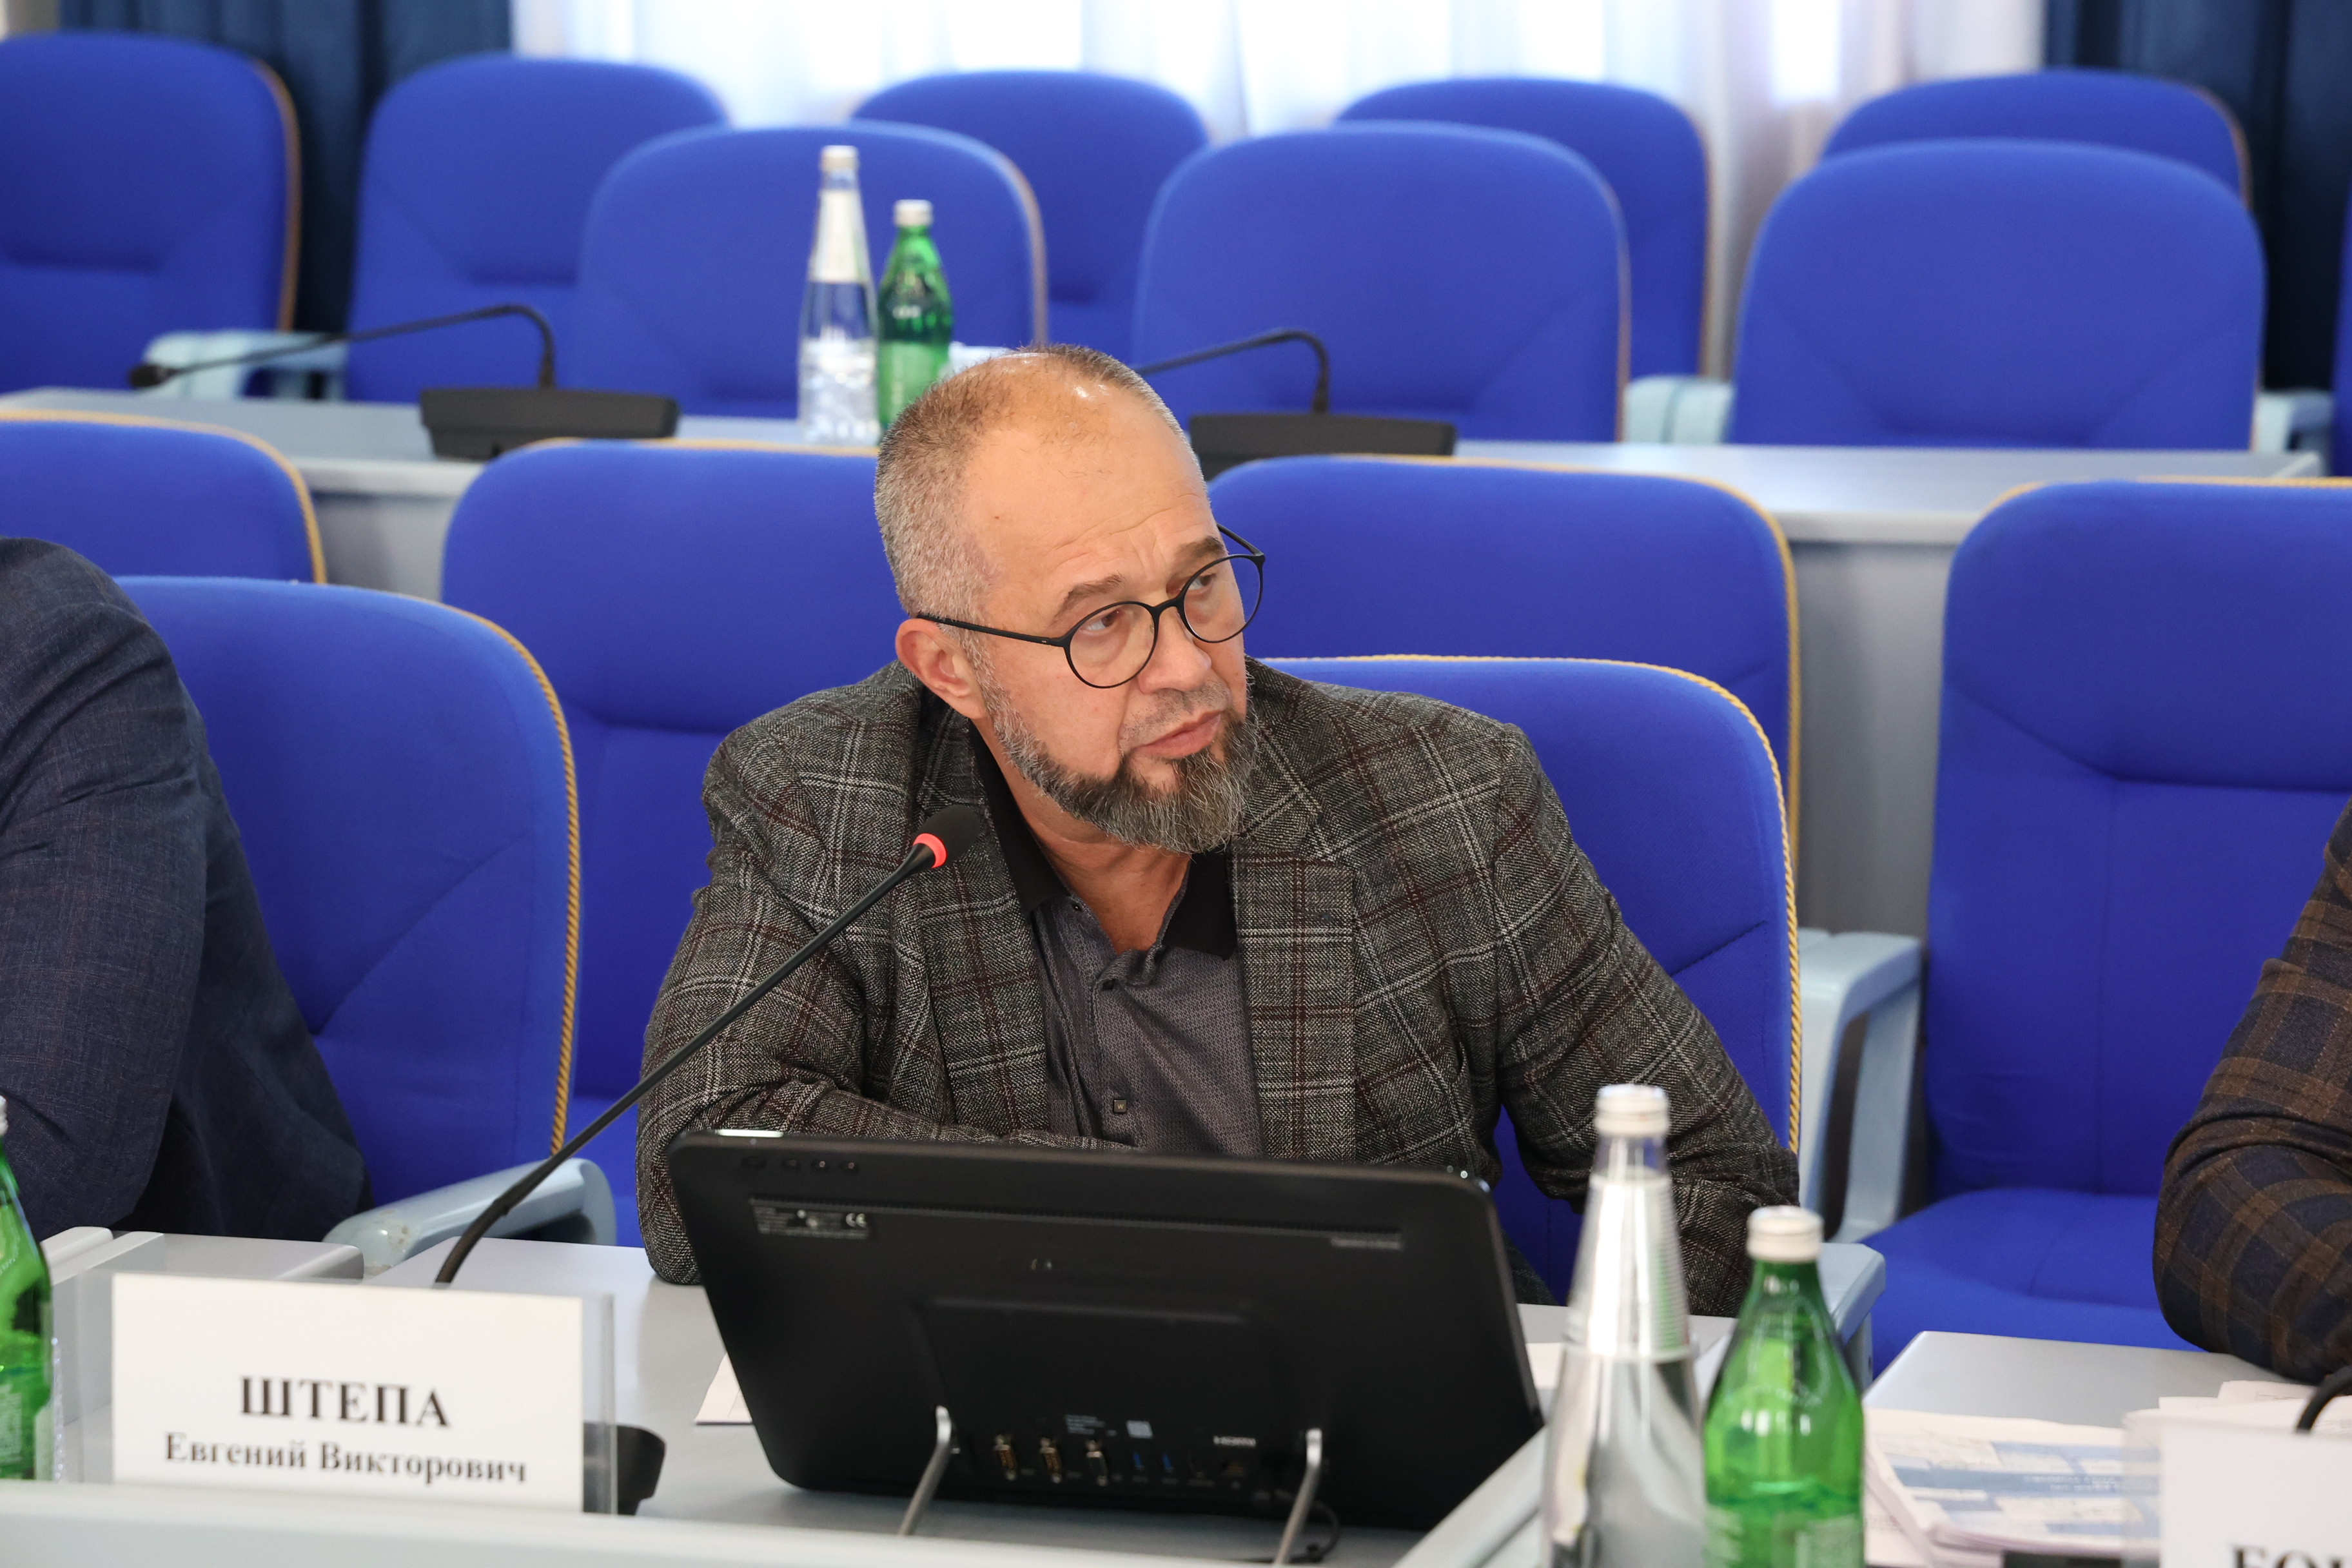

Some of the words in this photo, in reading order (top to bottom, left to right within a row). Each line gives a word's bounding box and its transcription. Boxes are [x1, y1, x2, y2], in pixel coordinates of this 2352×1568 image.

[241, 1376, 451, 1427] ШТЕПА
[166, 1432, 306, 1468] Евгений
[319, 1441, 526, 1485] Викторович
